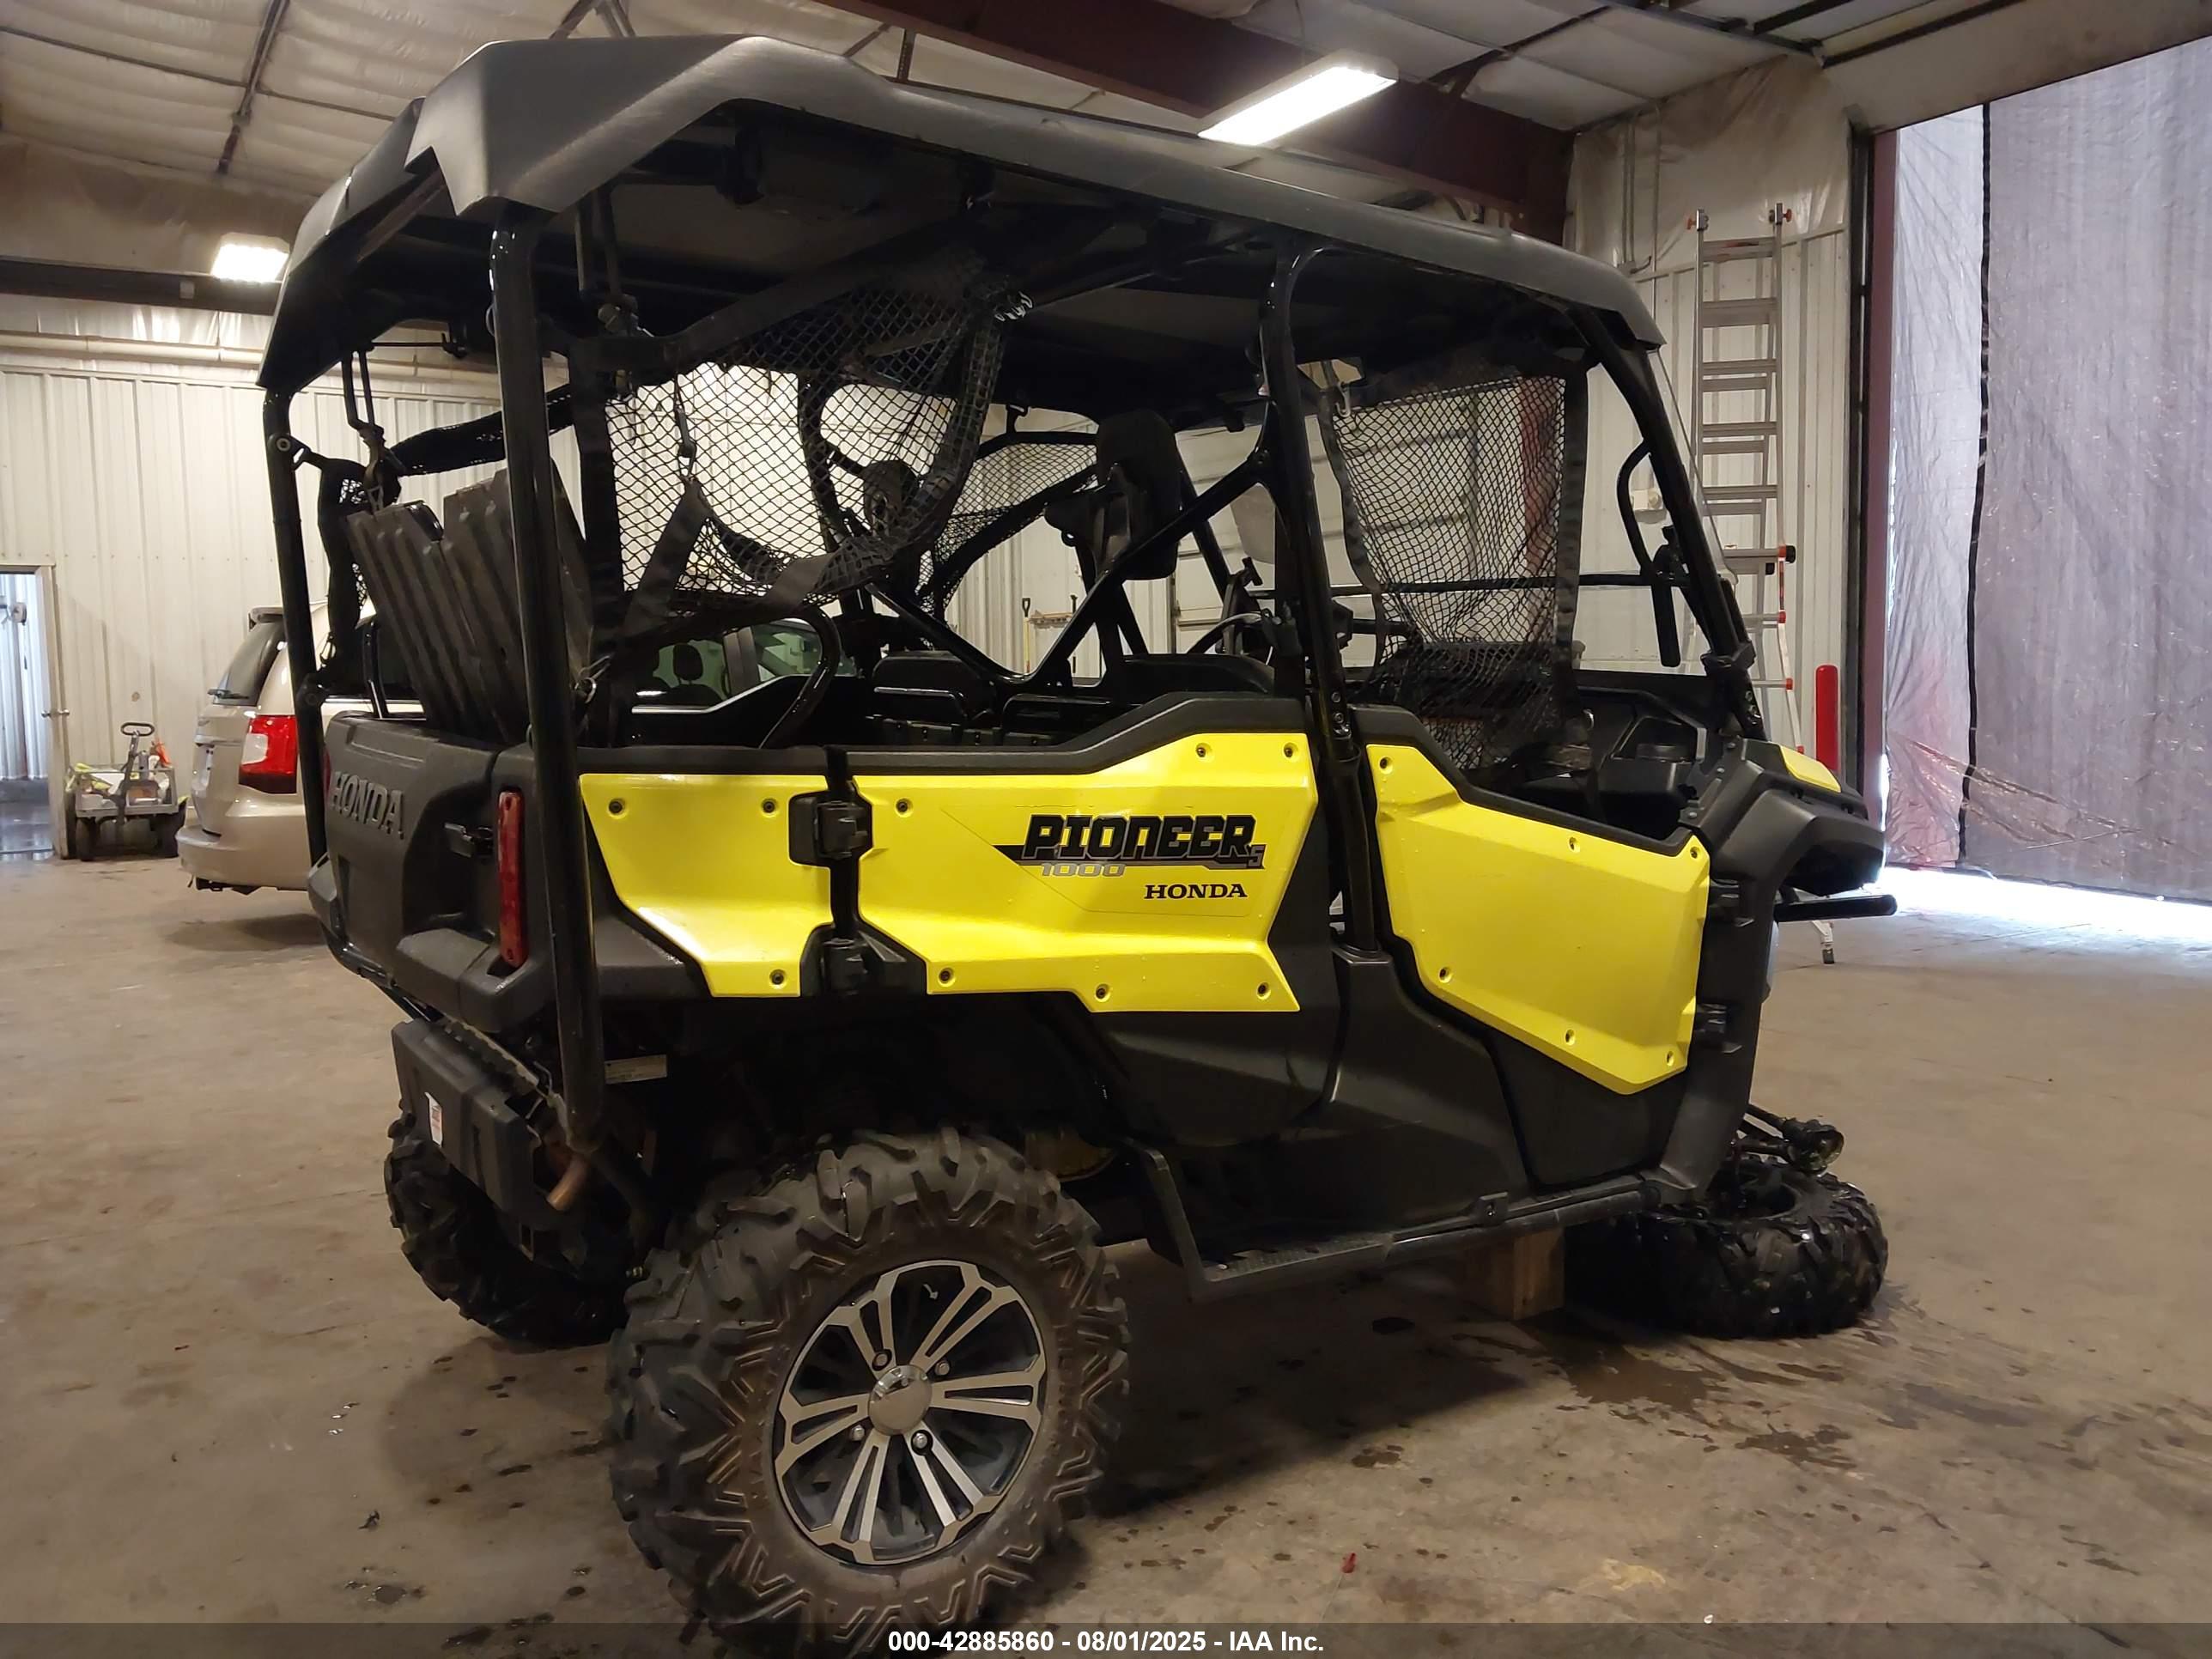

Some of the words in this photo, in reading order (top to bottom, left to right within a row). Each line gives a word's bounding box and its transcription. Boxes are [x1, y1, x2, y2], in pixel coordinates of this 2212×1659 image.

[330, 770, 404, 840] HONDA
[1022, 813, 1257, 859] PIONEER
[1041, 862, 1127, 878] 1000
[1143, 883, 1249, 900] HONDA
